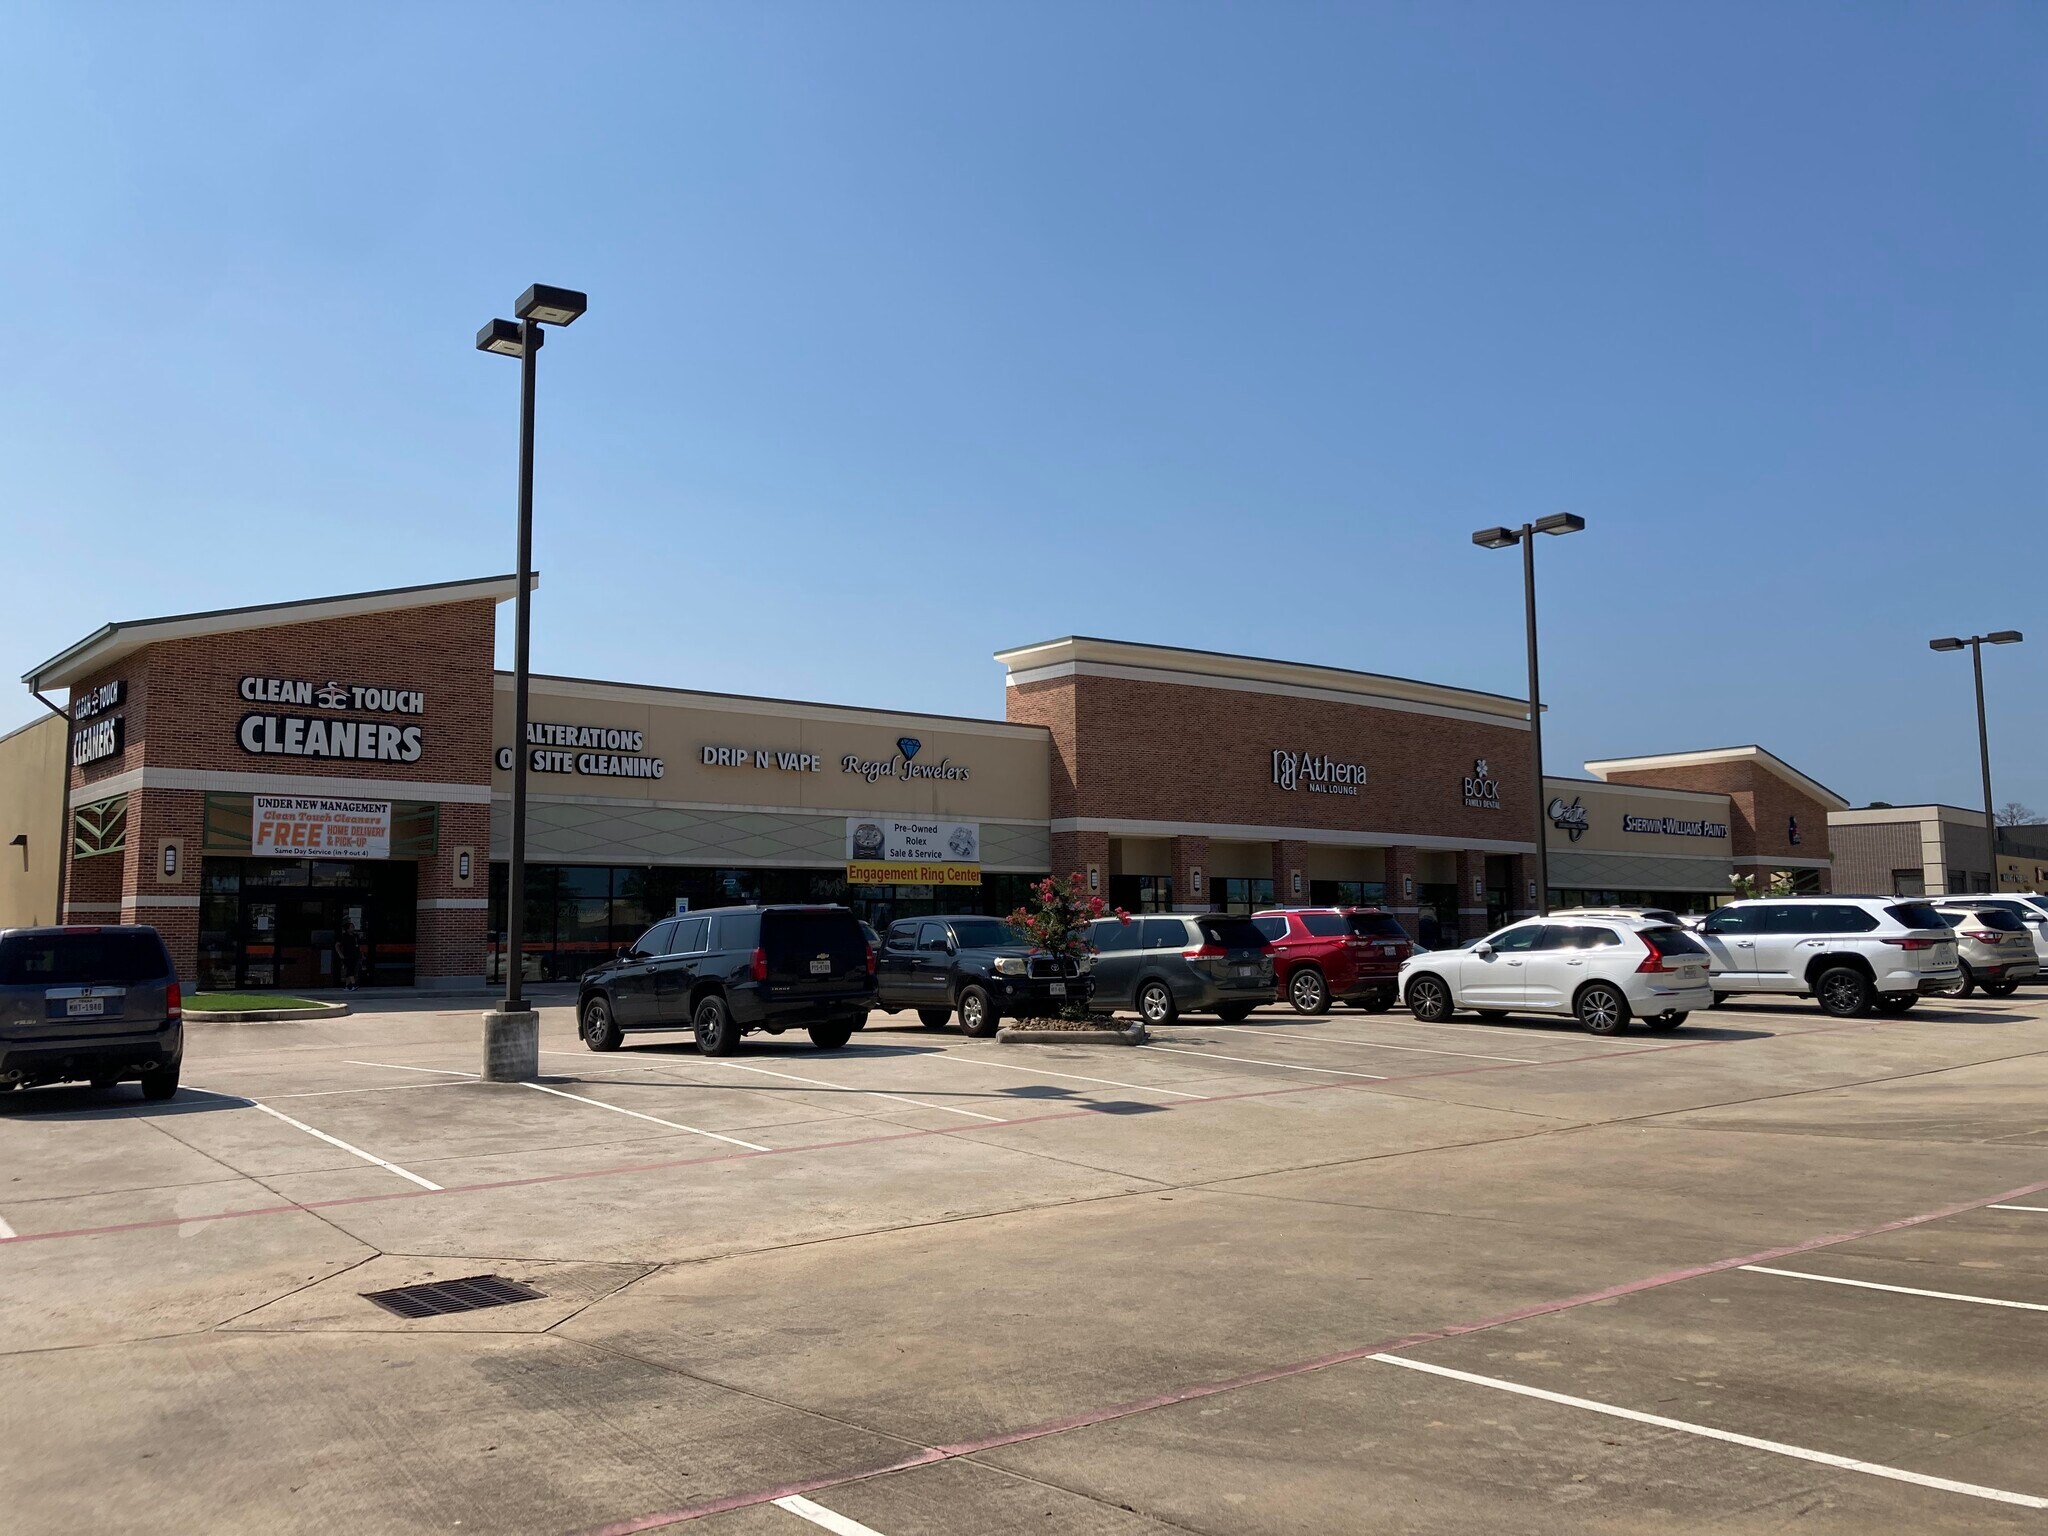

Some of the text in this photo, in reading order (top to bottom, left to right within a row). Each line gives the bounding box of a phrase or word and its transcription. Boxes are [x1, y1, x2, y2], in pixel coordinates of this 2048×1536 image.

[75, 680, 119, 720] CLEAN TOUCH
[240, 677, 424, 714] CLEAN TOUCH
[73, 717, 115, 766] CLEANERS
[241, 715, 422, 762] CLEANERS
[526, 722, 643, 751] ALTERATIONS
[533, 750, 573, 772] SITE
[577, 753, 665, 779] CLEANING
[702, 746, 821, 772] DRIP N VAPE
[842, 755, 970, 783] Regal Jewelers
[1298, 751, 1367, 785] Athena
[1309, 783, 1358, 796] NAIL LOUNGE
[1464, 777, 1500, 799] BOCK
[257, 798, 388, 814] UNDER NEW MANAGEMENT
[263, 811, 382, 825] Clean Touch Cleaners
[894, 823, 938, 834] Pre-Owned
[1625, 815, 1729, 838] SHERWIN-WILLIAMS PAINTS
[257, 821, 324, 847] FREE
[326, 824, 387, 838] HOME DELIVERY
[905, 836, 928, 846] Rolex
[294, 847, 307, 856] Day
[308, 848, 332, 856] Service
[334, 837, 368, 848] PICK-UP
[889, 848, 943, 859] Sale & Service
[848, 865, 919, 883] Engagement
[919, 867, 945, 884] Ring
[946, 867, 982, 882] Center
